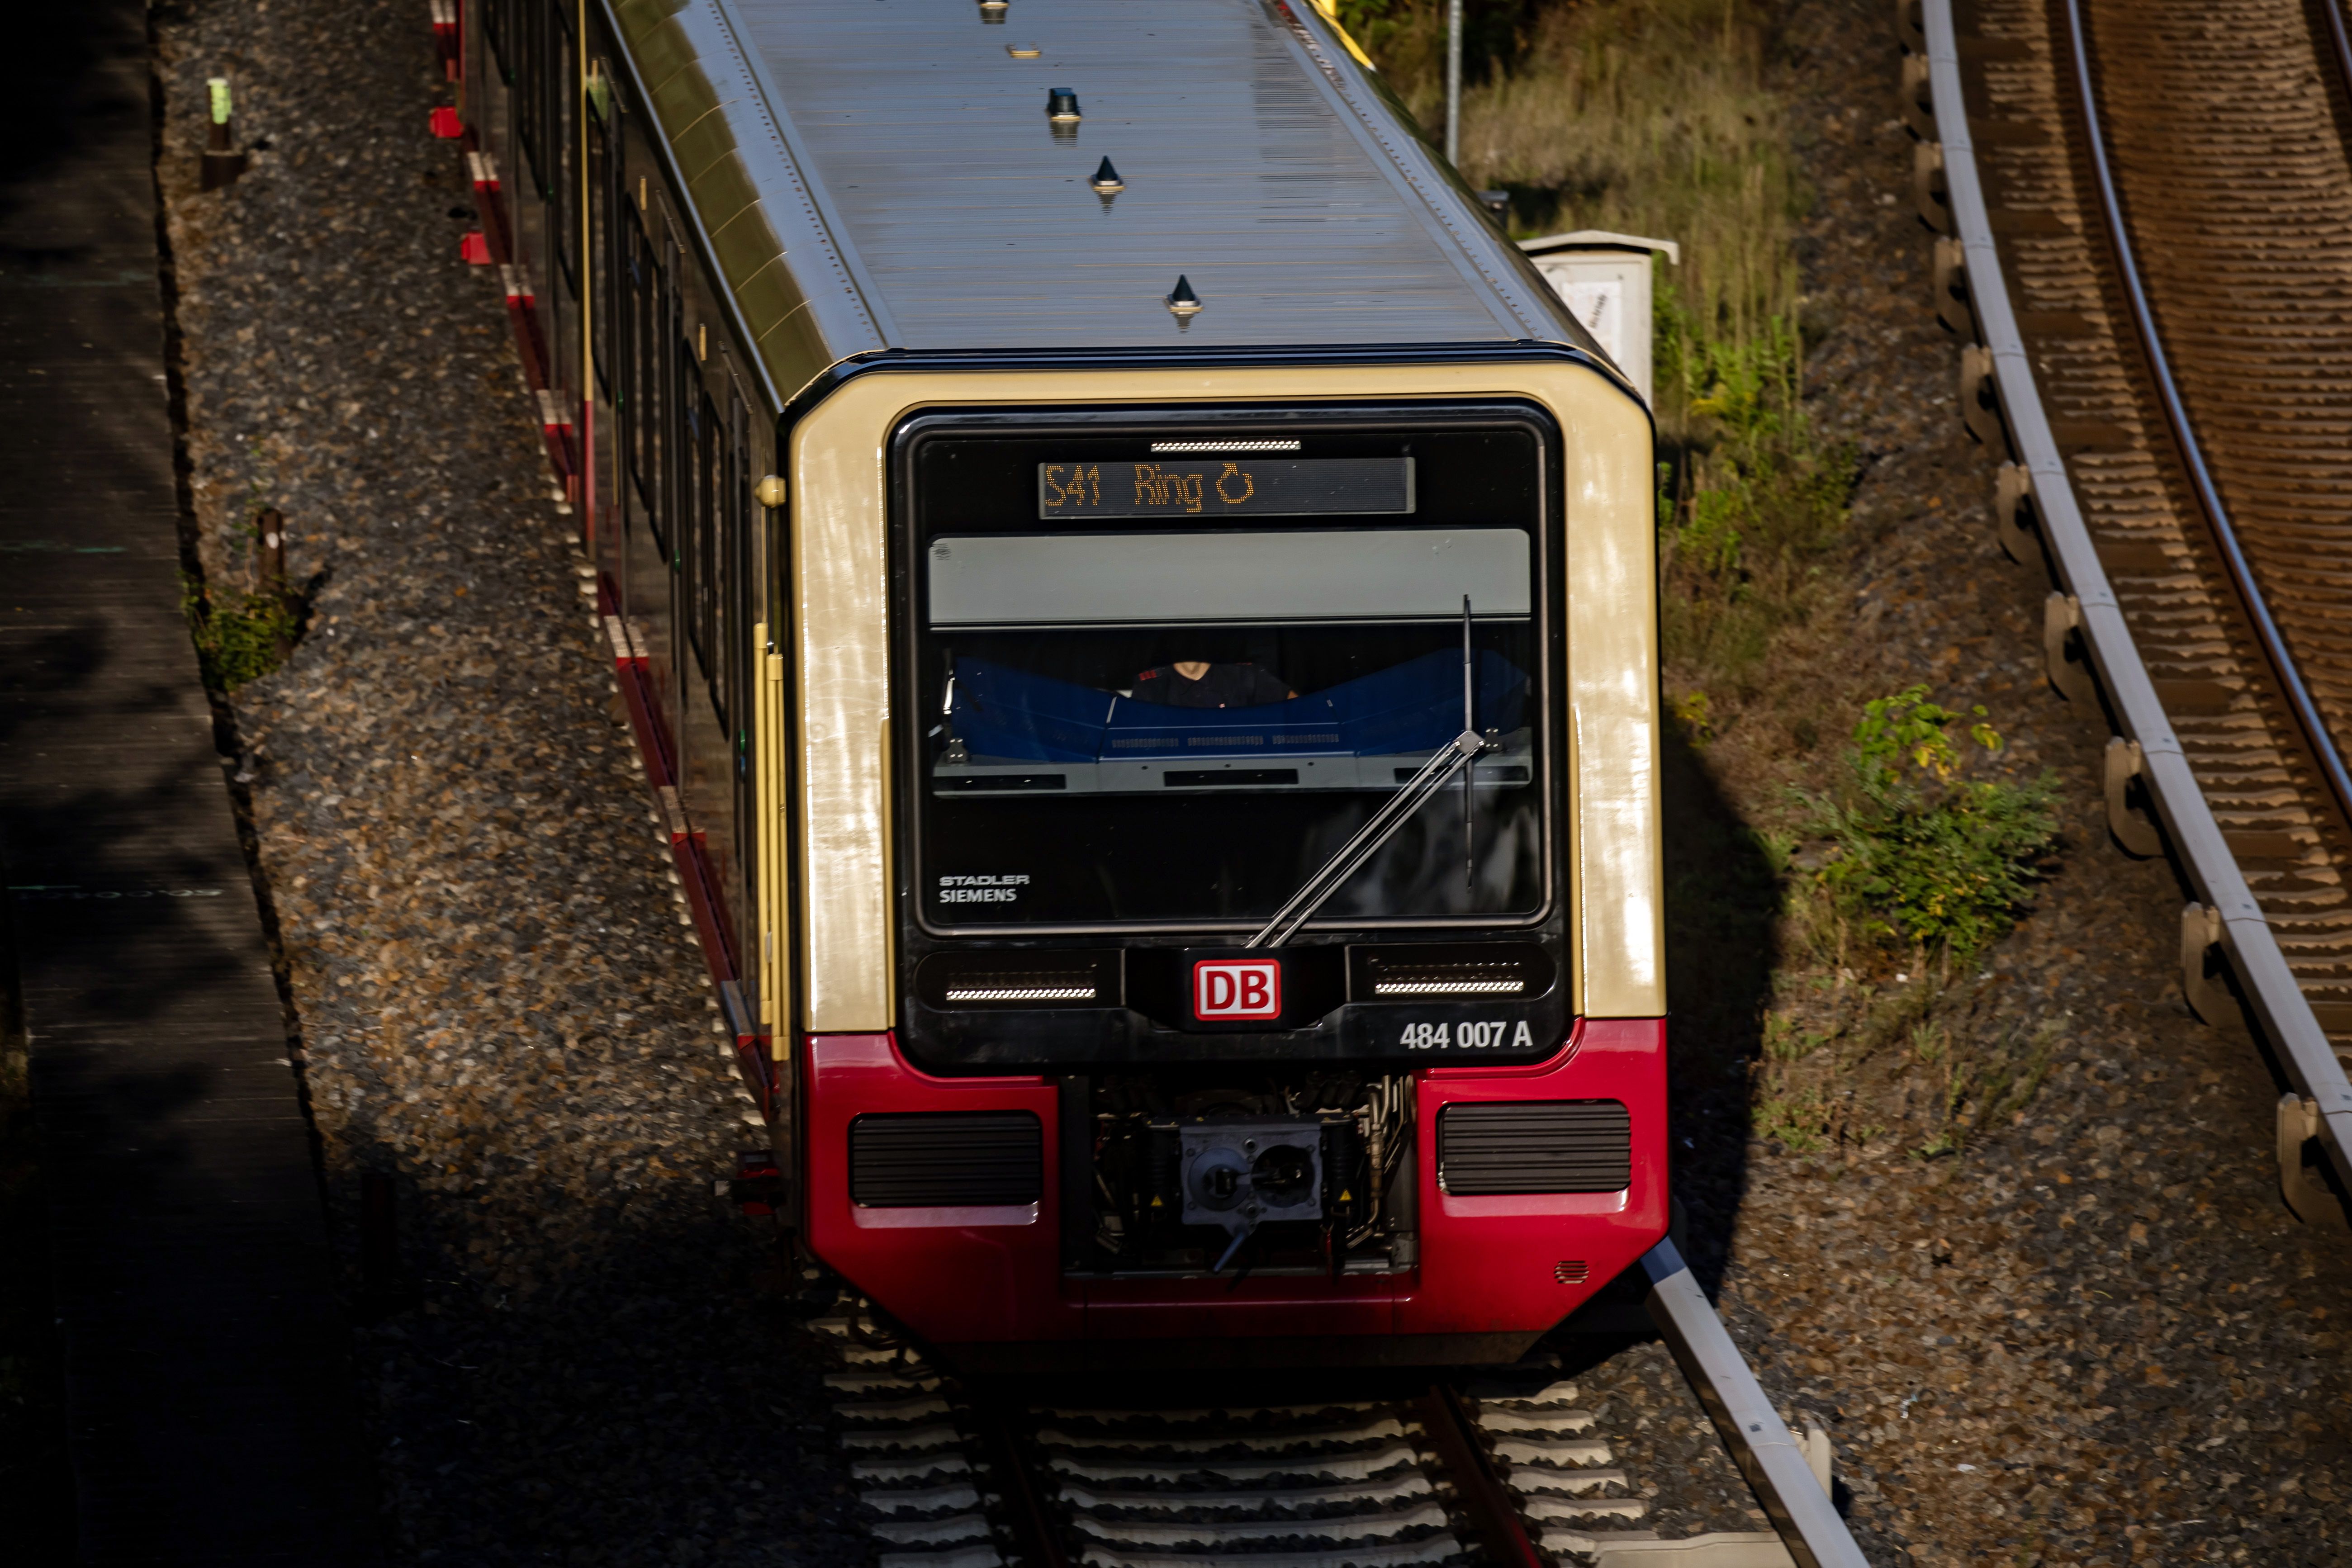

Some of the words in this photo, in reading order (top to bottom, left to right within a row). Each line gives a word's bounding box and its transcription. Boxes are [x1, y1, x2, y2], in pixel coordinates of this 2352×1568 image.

[1046, 465, 1100, 507] S41
[1134, 464, 1203, 513] Ring
[939, 875, 1030, 886] STADLER
[939, 888, 1017, 903] SIEMENS
[1205, 970, 1269, 1011] DB
[1400, 1022, 1451, 1049] 484
[1456, 1021, 1507, 1048] 007
[1512, 1020, 1533, 1047] A
